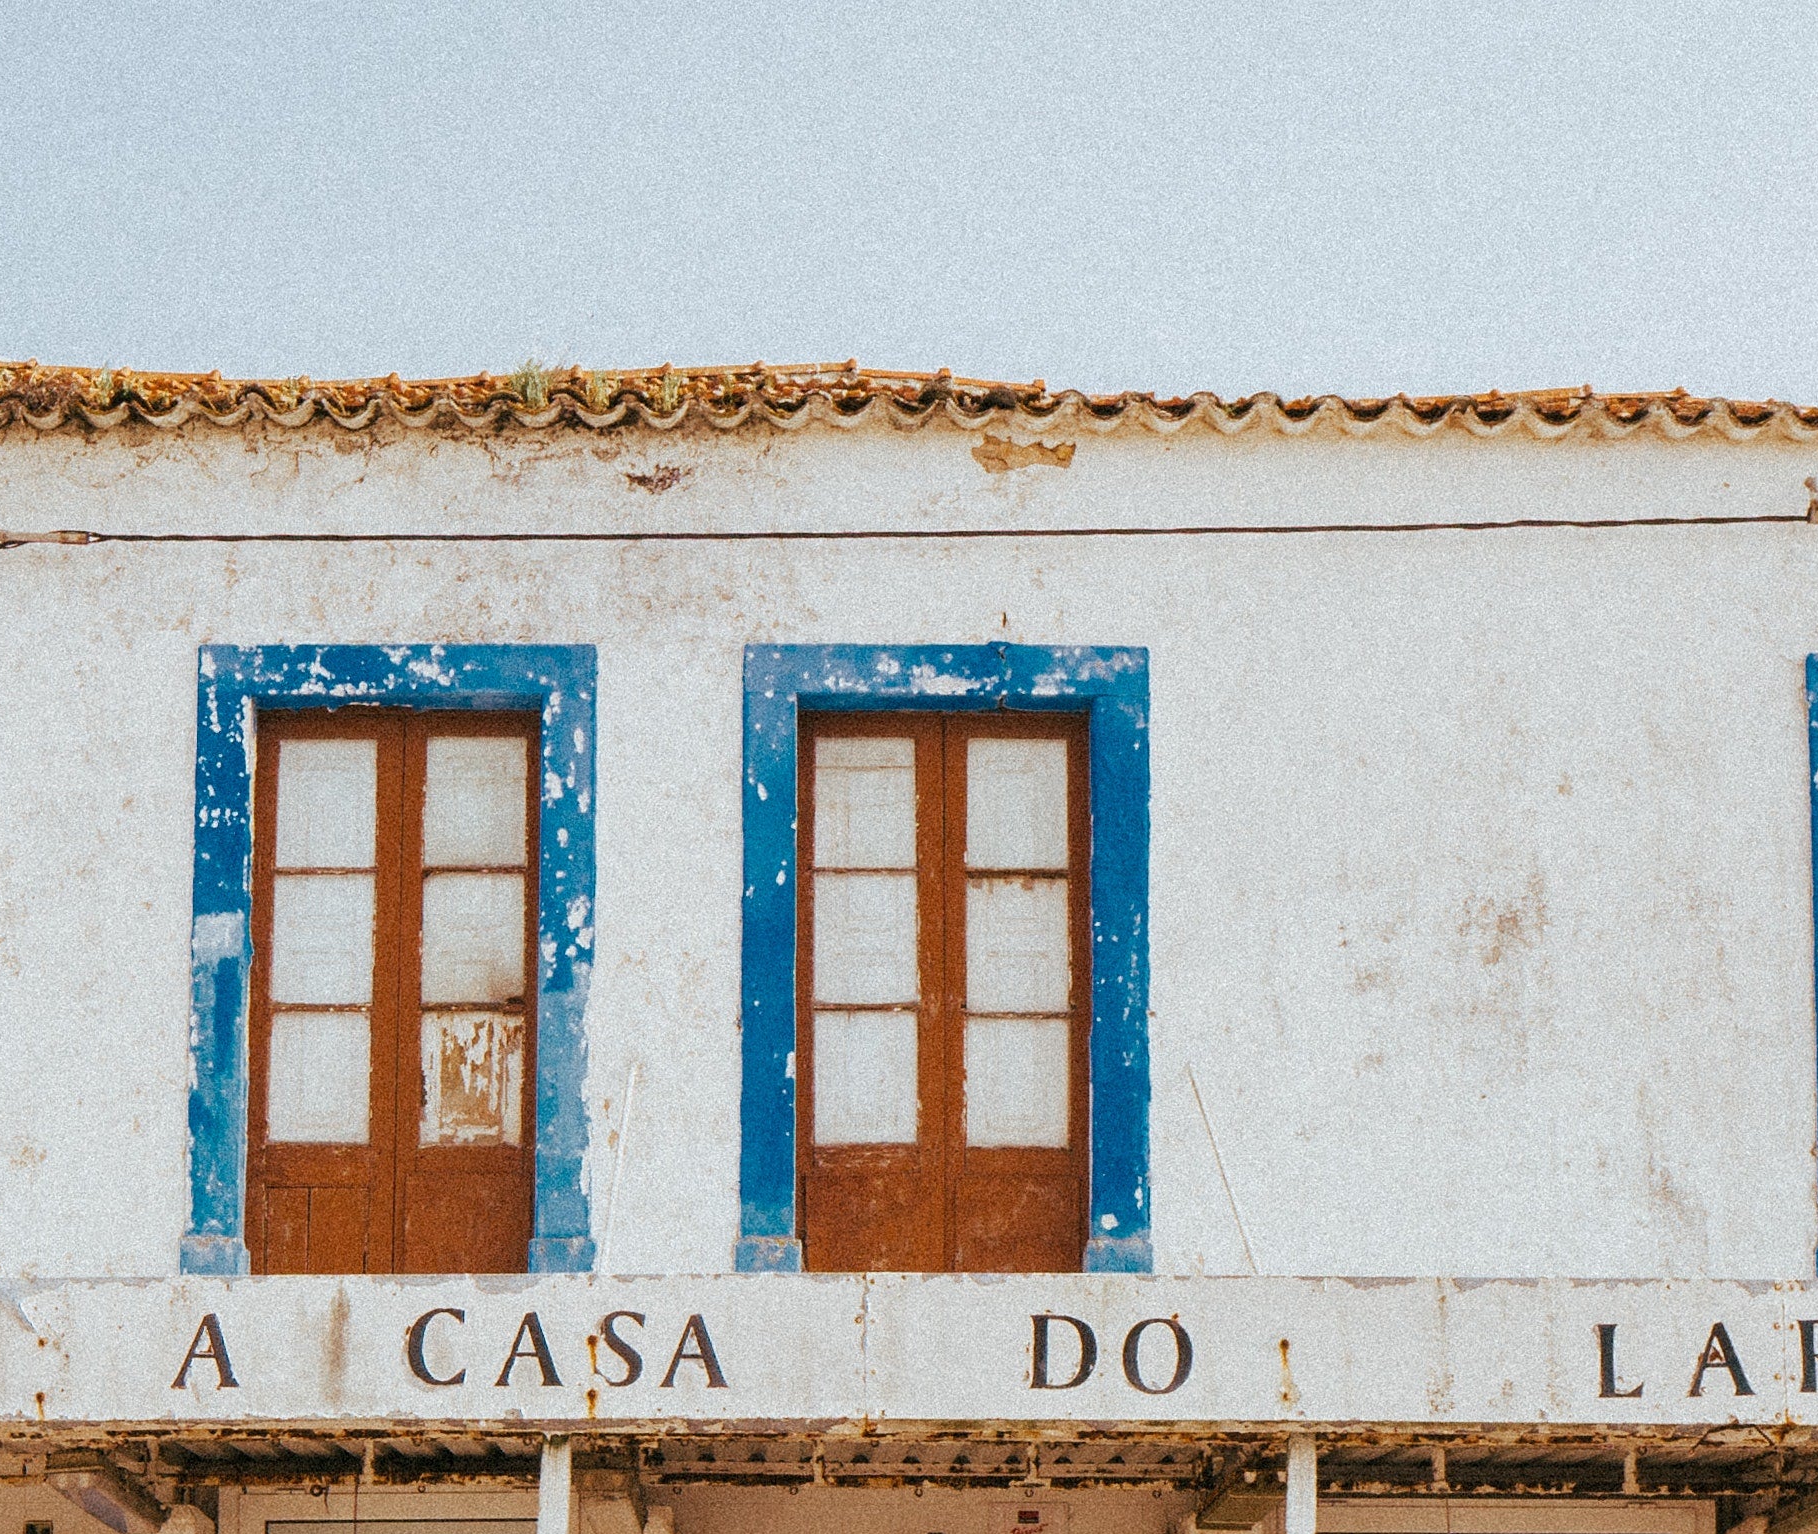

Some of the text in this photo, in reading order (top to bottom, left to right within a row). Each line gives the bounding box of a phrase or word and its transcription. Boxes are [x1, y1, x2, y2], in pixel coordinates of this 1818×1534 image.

[170, 1312, 240, 1390] A
[404, 1307, 730, 1389] CASA
[1028, 1314, 1194, 1395] DO
